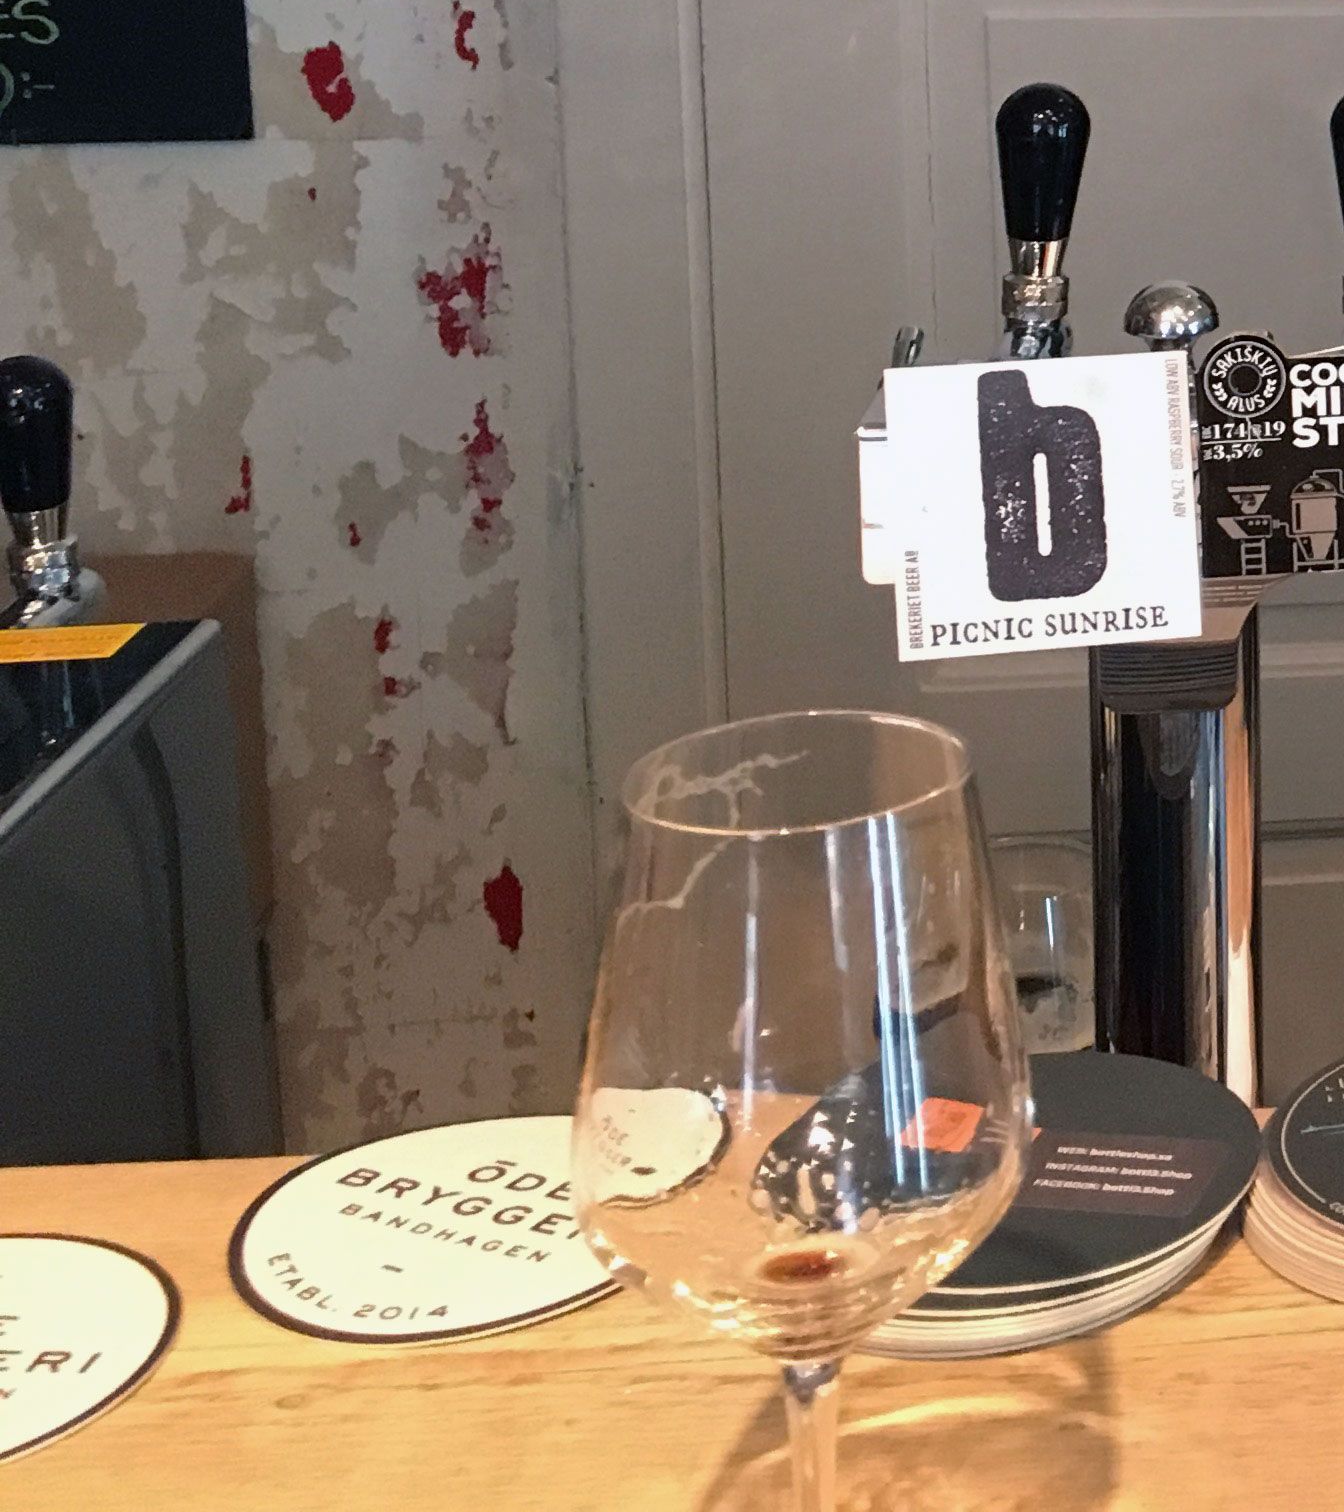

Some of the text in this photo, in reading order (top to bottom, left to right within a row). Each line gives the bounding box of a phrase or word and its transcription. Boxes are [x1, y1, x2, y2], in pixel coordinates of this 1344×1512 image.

[1164, 358, 1179, 378] LOW
[1166, 379, 1180, 395] ABV
[1226, 393, 1266, 412] ALUS
[1167, 397, 1184, 446] RASPBERRY
[1169, 447, 1185, 471] SOUR
[1212, 442, 1264, 463] 3,5%
[905, 566, 921, 593] BEER
[929, 604, 1170, 648] PICNIC SUNRISE
[339, 1202, 550, 1263] BANDHAGEN
[352, 1304, 450, 1321] 2014
